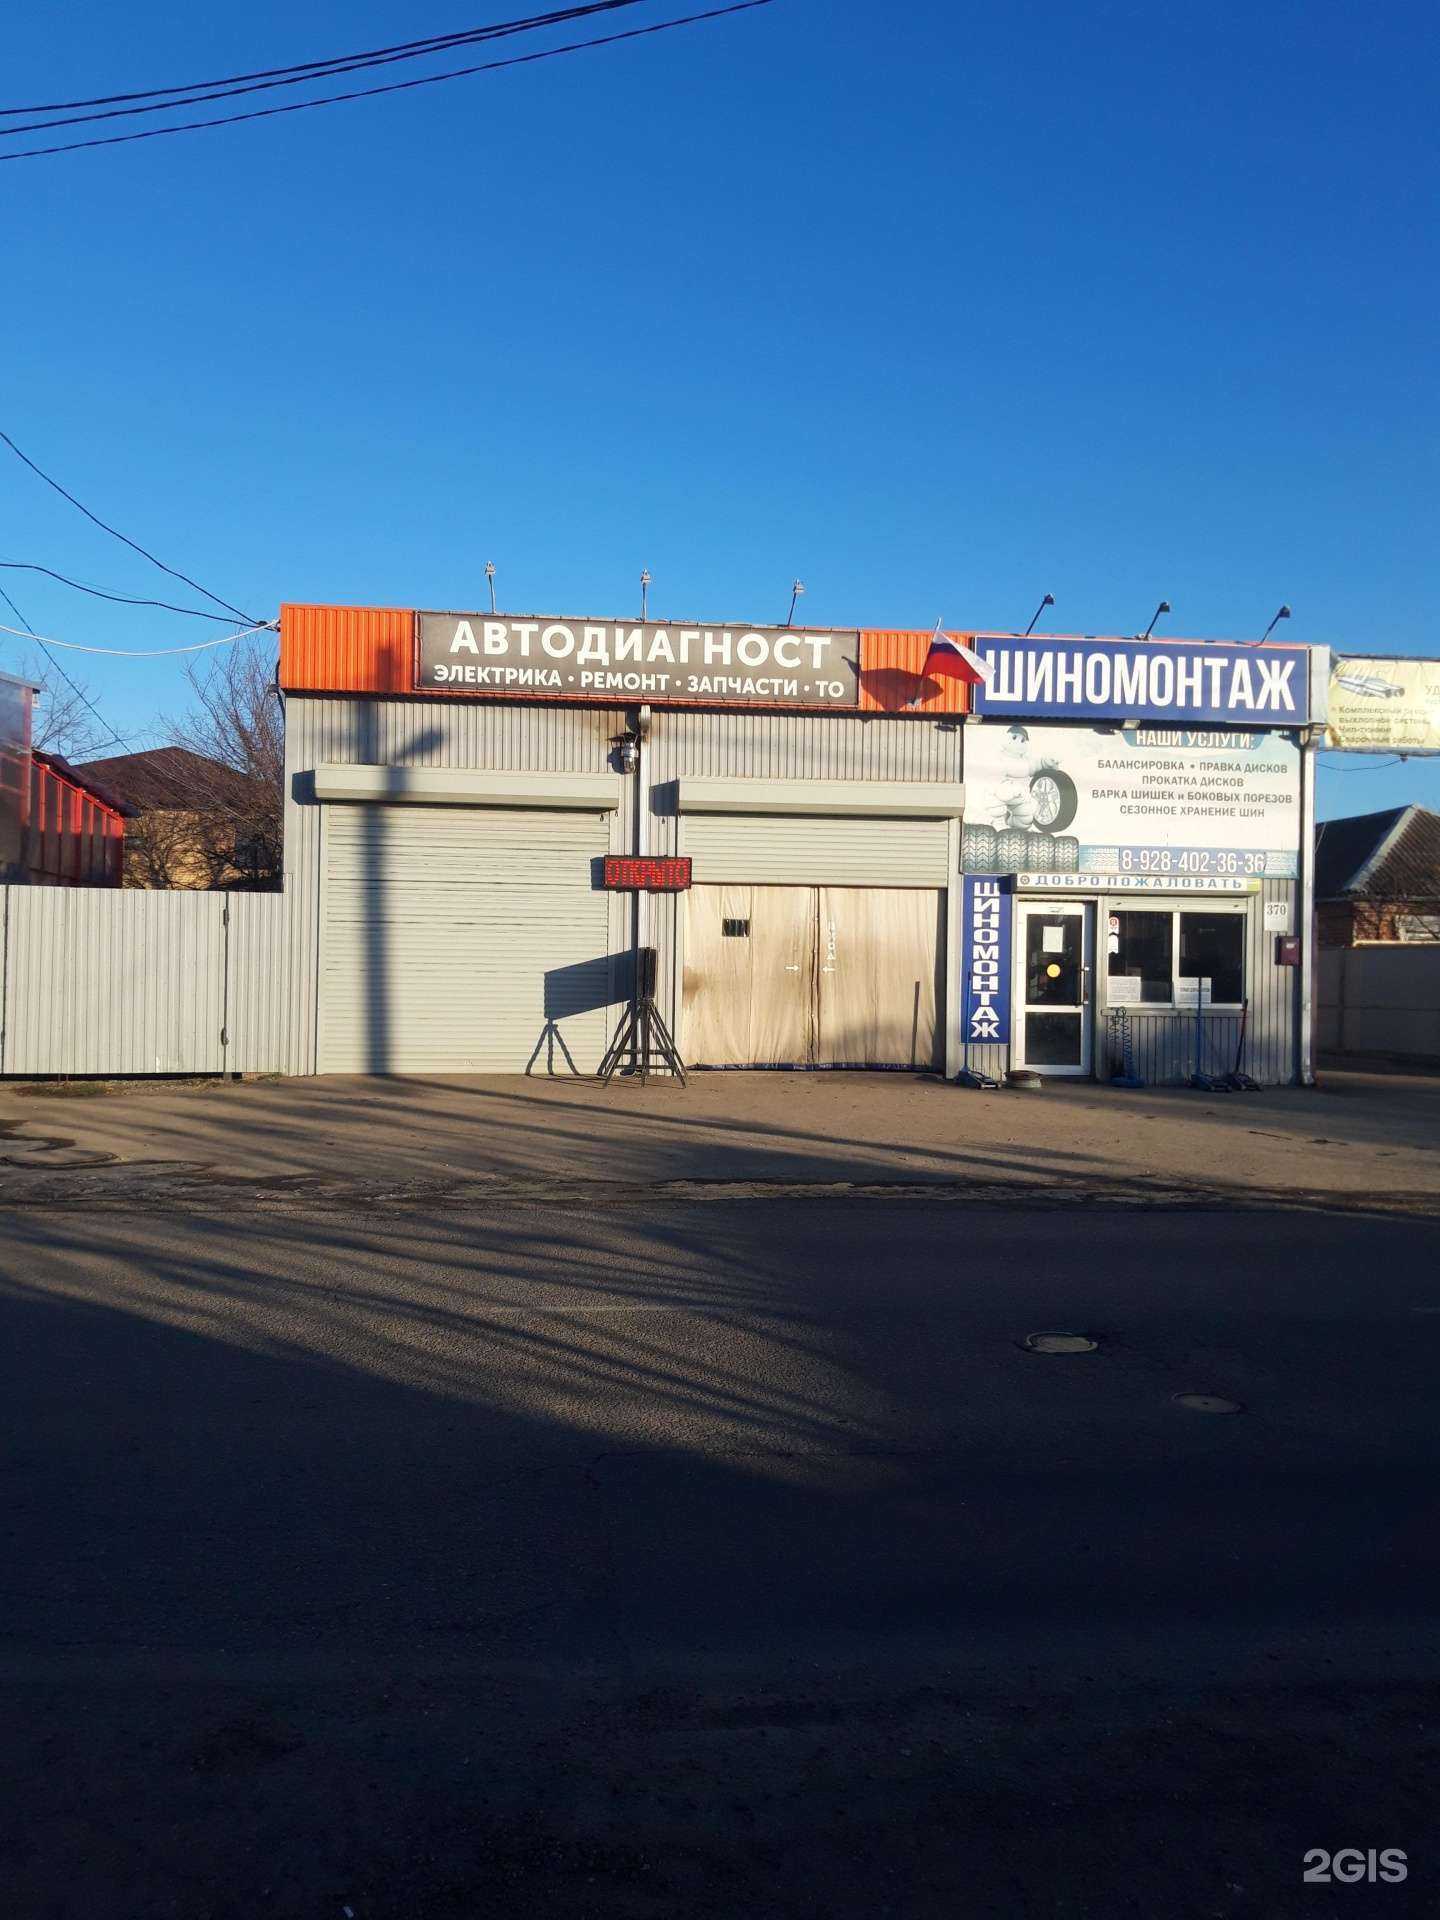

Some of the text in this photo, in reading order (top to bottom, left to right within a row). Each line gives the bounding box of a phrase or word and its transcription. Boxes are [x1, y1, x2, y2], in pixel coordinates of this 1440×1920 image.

[449, 620, 831, 669] АВТОДИАГНОСТ
[433, 663, 845, 698] ЭЛЕКТРИКА РЕМОНТ ЗАПЧАСТИ ТО
[984, 649, 1296, 711] ШИНОМОНТАЖ
[1136, 730, 1255, 749] НАШИ УСЛУГИ:
[1097, 759, 1288, 774] БАЛАНСИРОВКА ПРАВКА ДИСКОВ
[1142, 775, 1244, 787] ПРОКАТКА ДИСКОВ
[1091, 789, 1128, 800] ВАРКА
[1131, 790, 1174, 800] ШИШЕК
[1187, 791, 1240, 802] БОКОВЫХ
[1243, 793, 1293, 803] ПОРЕЗОВ
[1120, 804, 1265, 818] СЕЗОННОЕ ХРАНЕНИЕ ШИН
[1122, 850, 1266, 874] 8-928-402-36-36
[1035, 875, 1242, 889] ДОБРО ПОЖАЛОВАТЬ
[971, 881, 1000, 1038] ШИНОМОНТАЖ
